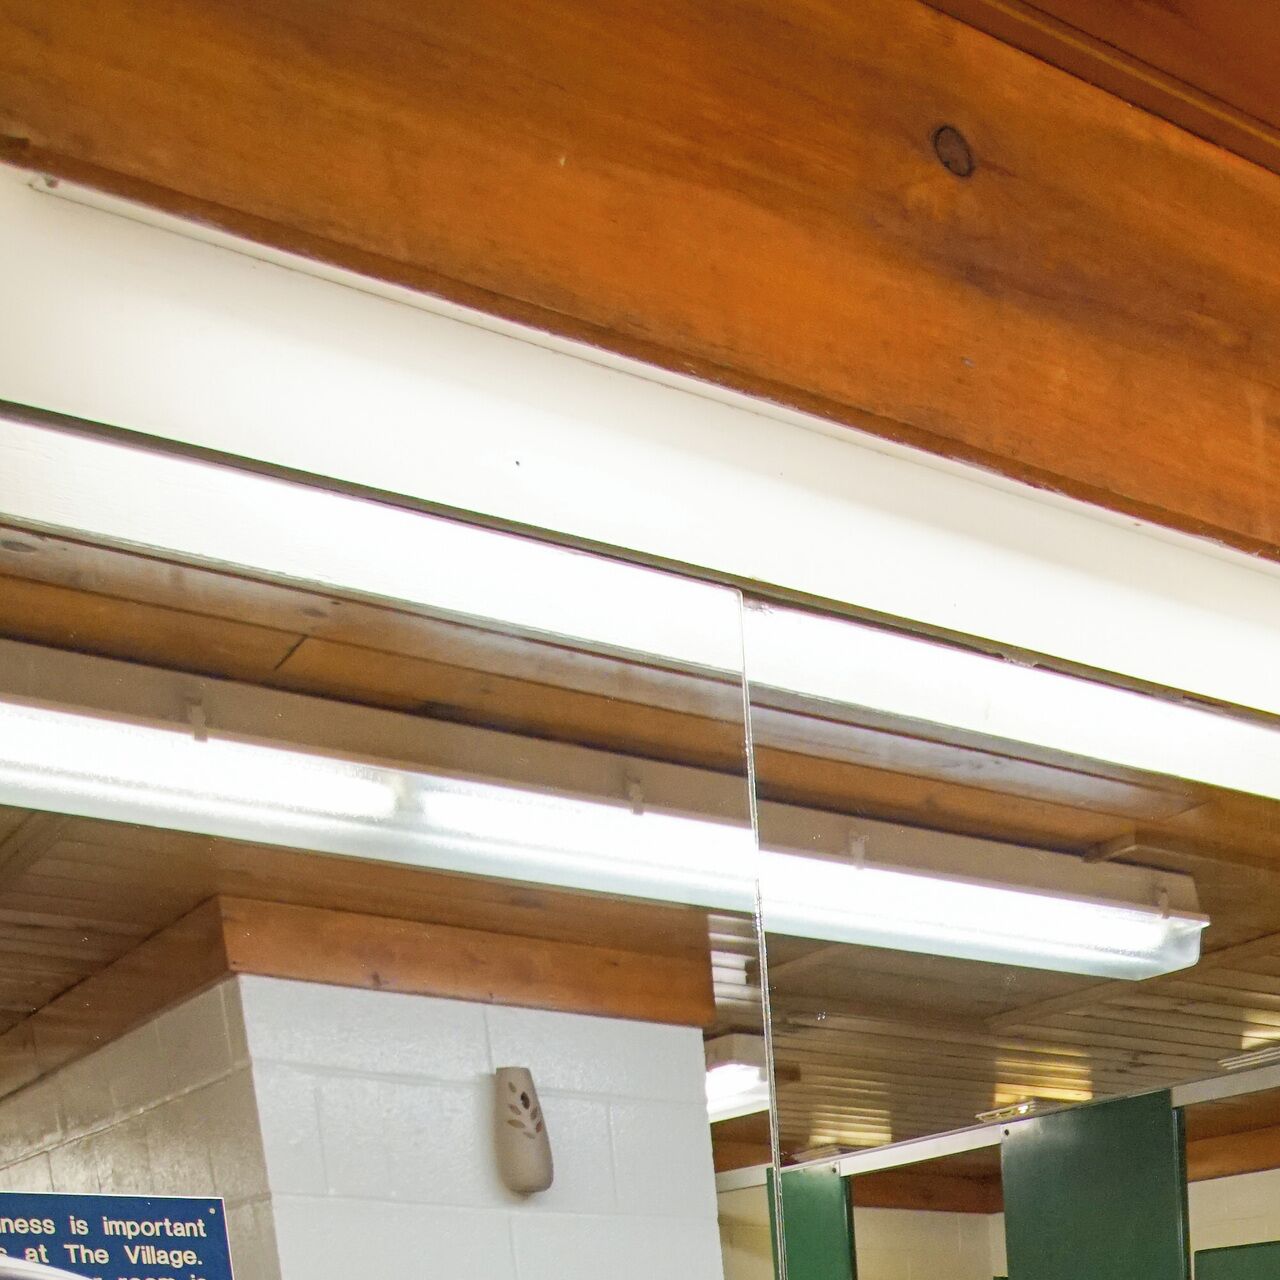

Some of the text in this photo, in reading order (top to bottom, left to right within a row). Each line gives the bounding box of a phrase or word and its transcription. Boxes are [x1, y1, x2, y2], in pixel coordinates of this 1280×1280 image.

[0, 1215, 207, 1240] ness is important
[25, 1244, 49, 1263] at
[63, 1244, 110, 1264] The
[124, 1245, 203, 1268] Village.
